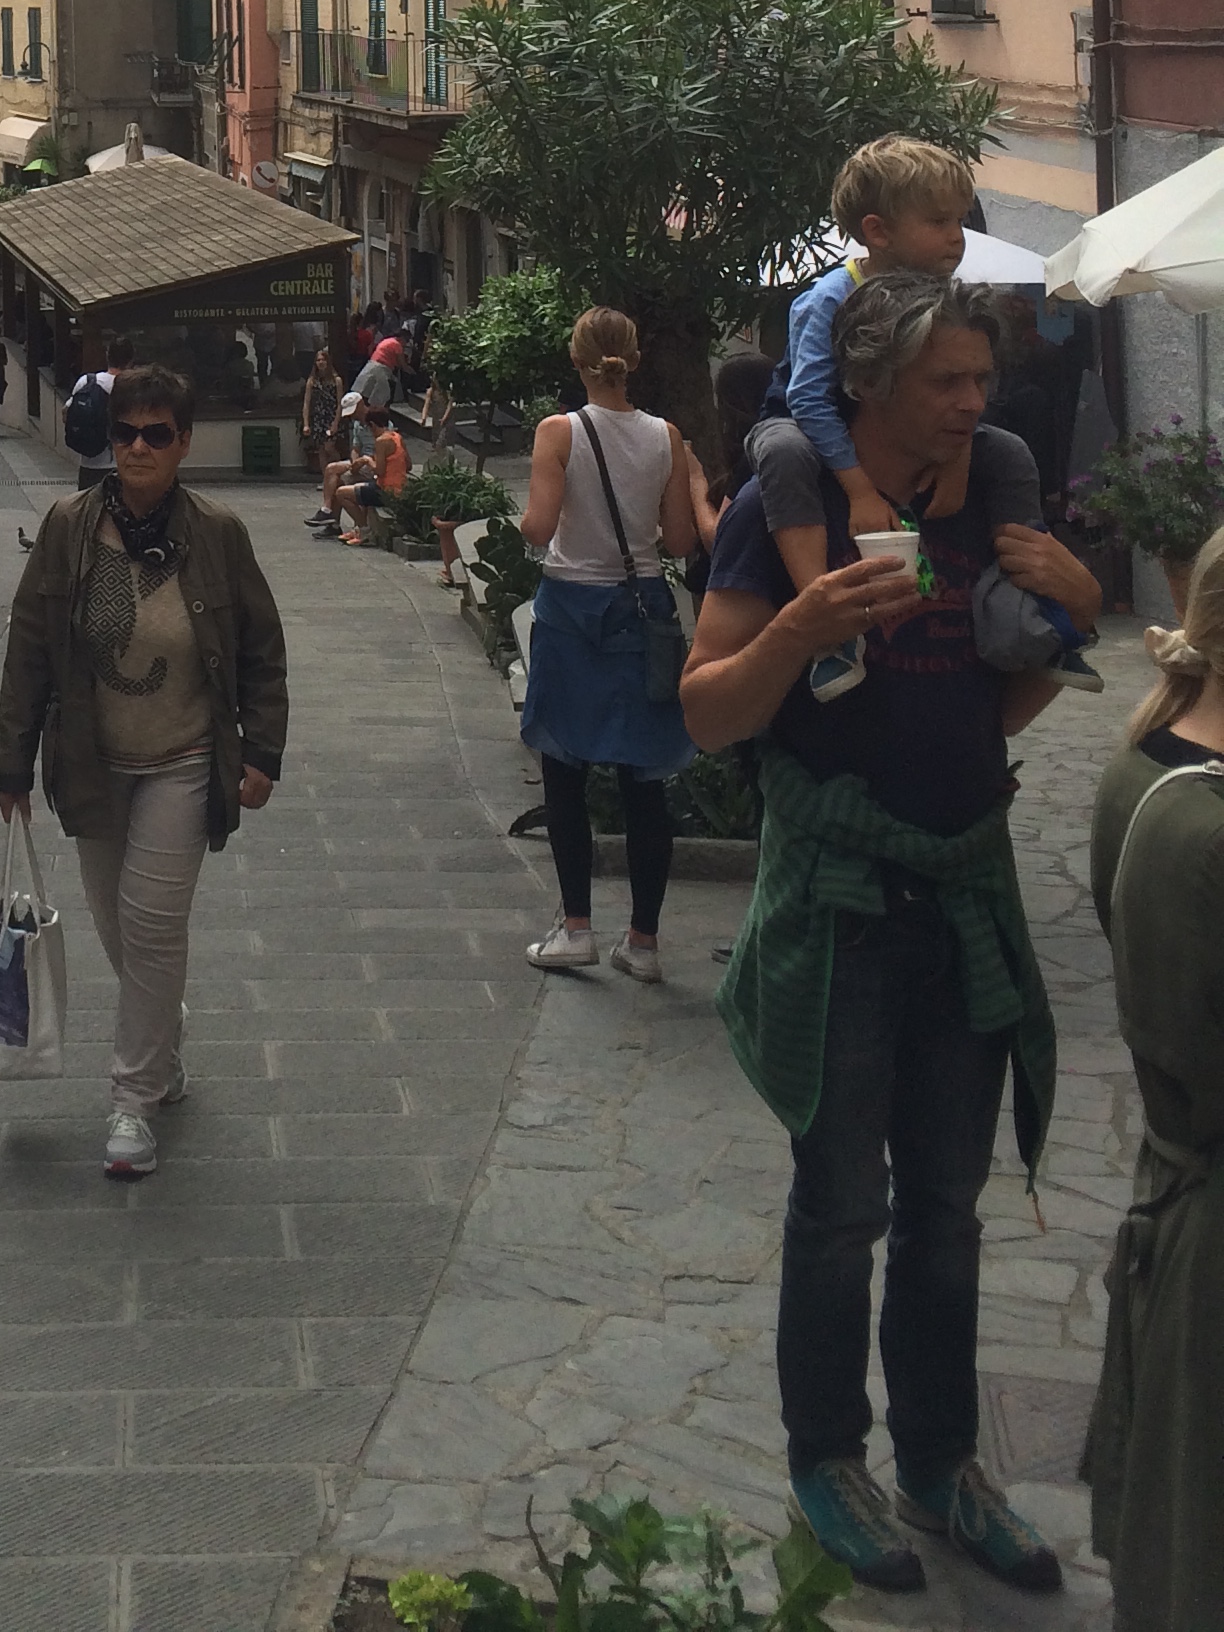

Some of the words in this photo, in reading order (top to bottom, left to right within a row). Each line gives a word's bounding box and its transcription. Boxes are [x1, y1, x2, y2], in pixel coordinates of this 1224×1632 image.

[307, 263, 333, 278] BAR
[270, 279, 335, 296] CENTRALE
[174, 308, 225, 318] RISTORANTE
[235, 306, 279, 317] GELATERIA
[281, 305, 335, 316] ARTIGIANALE
